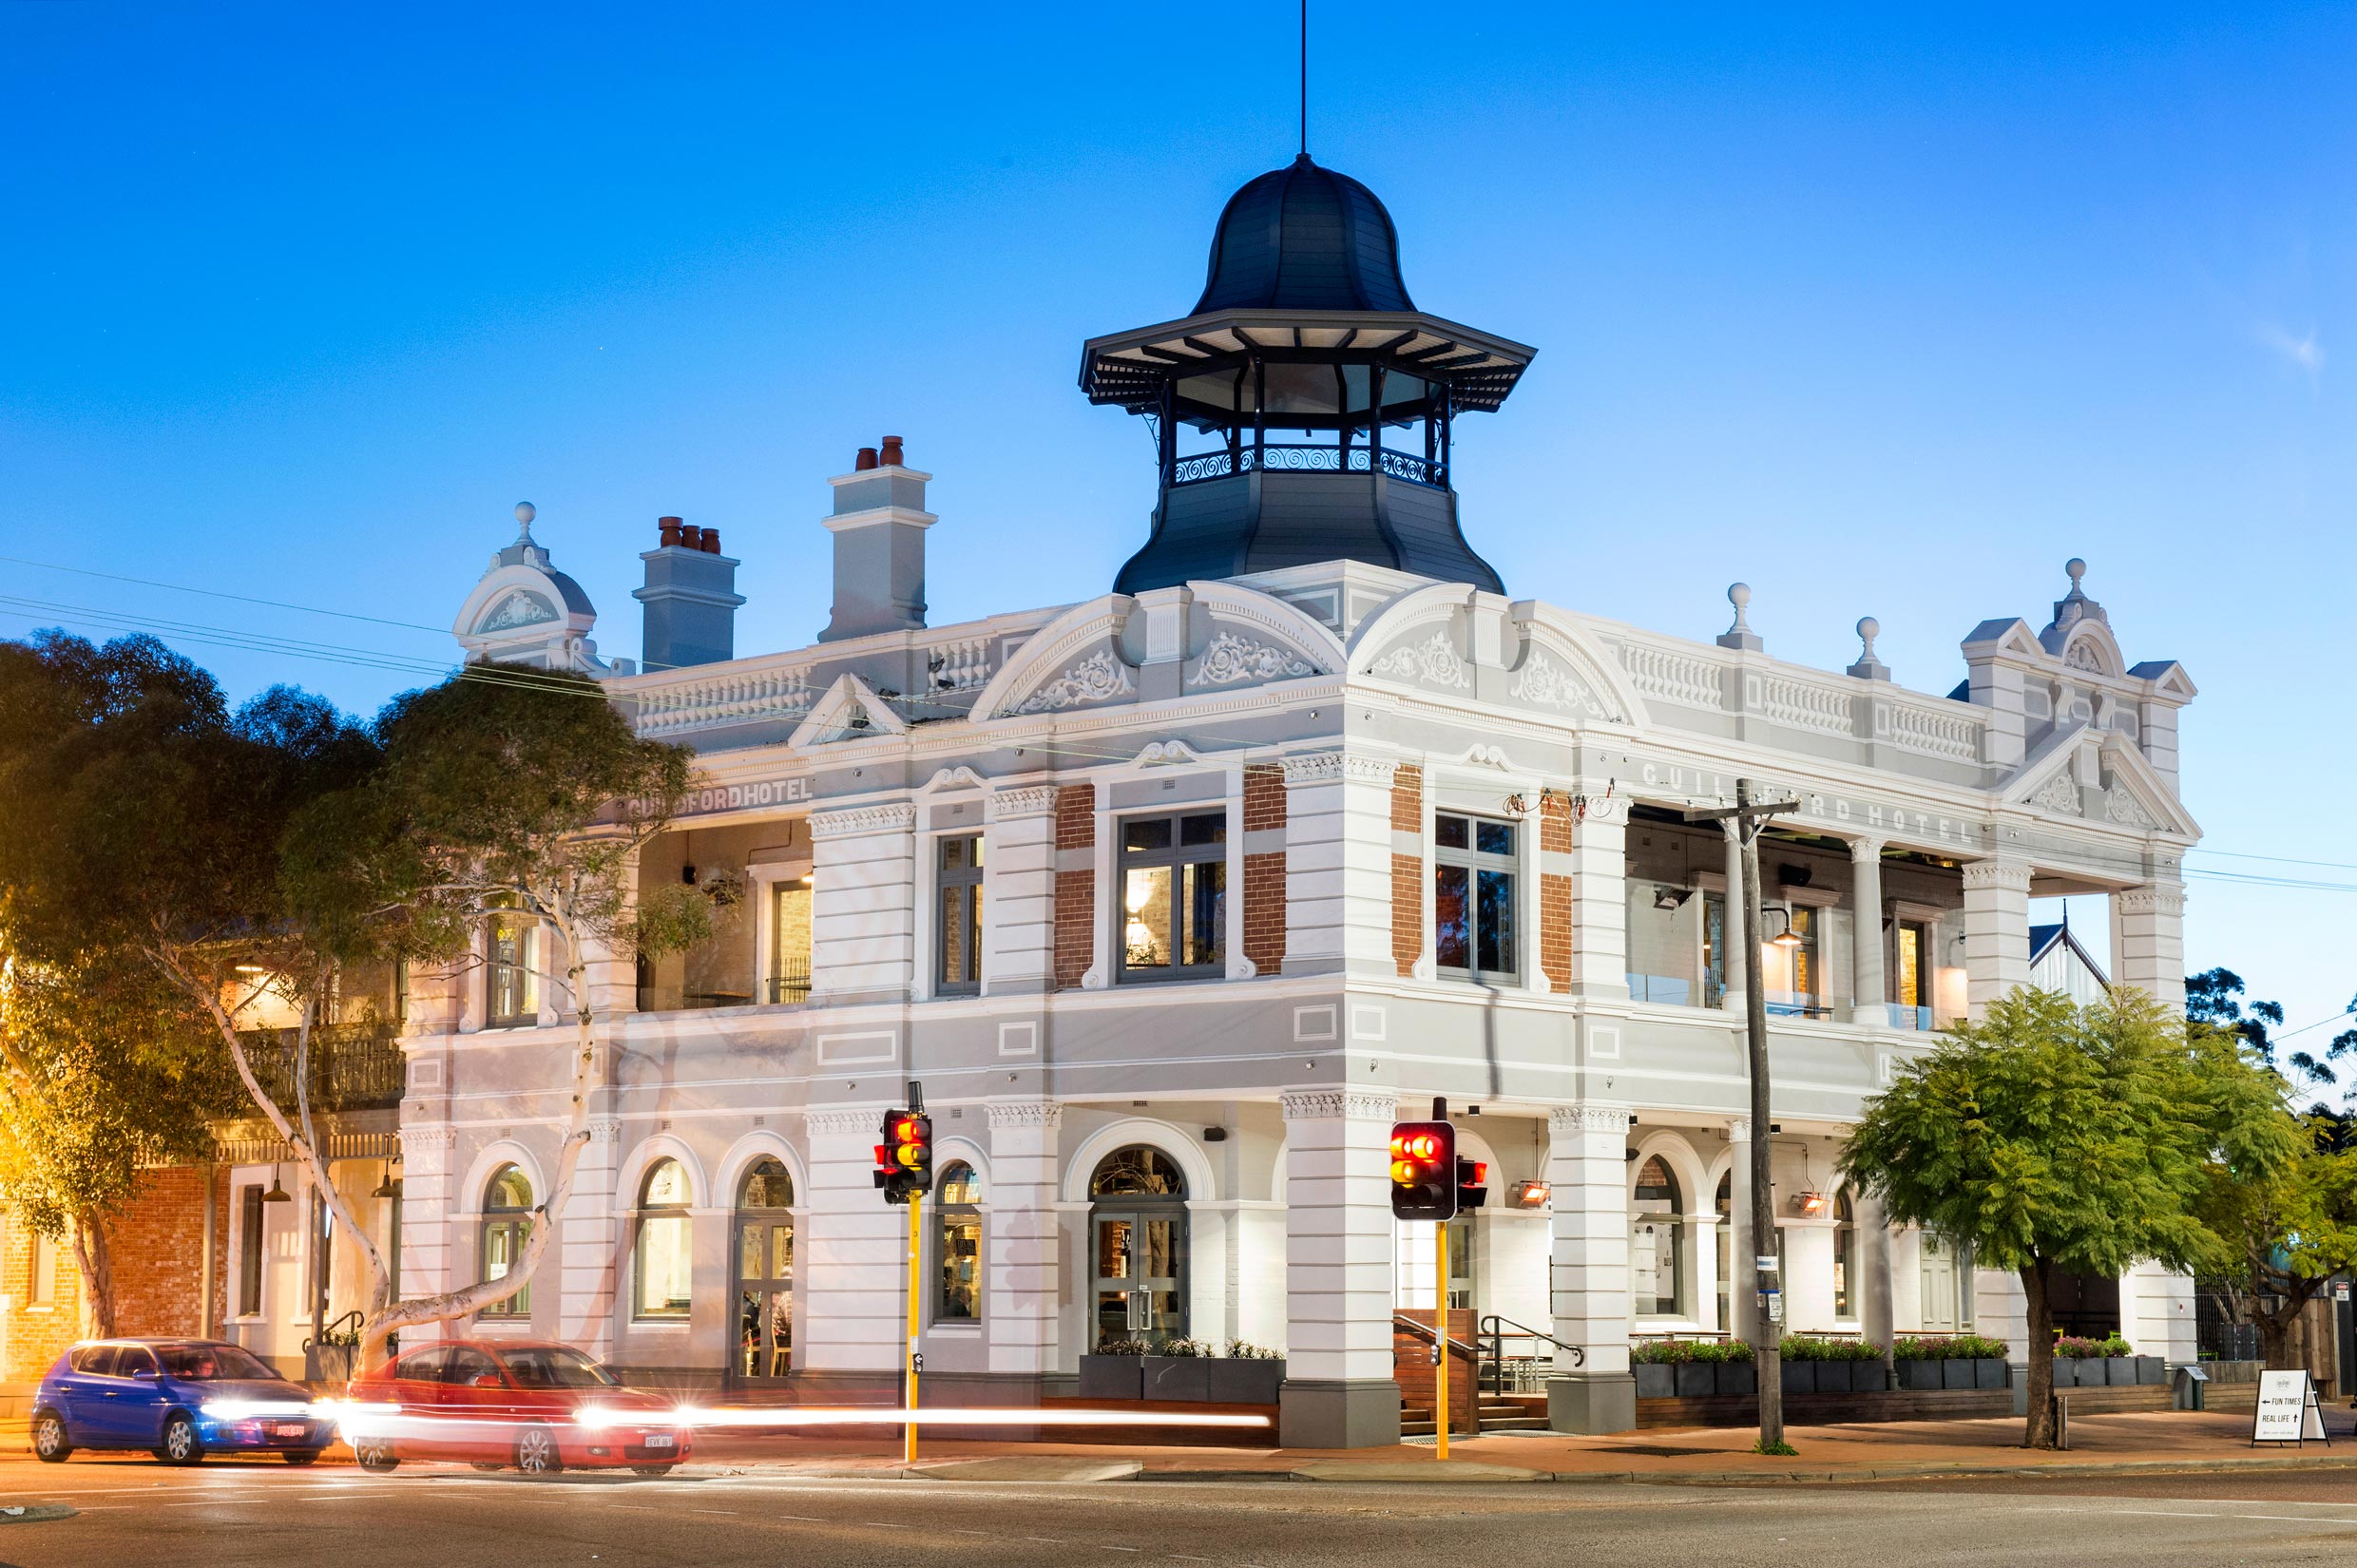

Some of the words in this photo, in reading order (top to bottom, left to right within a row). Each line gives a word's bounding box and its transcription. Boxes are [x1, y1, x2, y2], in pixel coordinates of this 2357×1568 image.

[743, 777, 814, 806] HOTEL
[1642, 763, 1850, 820] GUILFRD
[1868, 805, 1972, 844] HOTEL
[2271, 1397, 2283, 1405] FUN
[2284, 1397, 2302, 1405] TIMES
[2262, 1414, 2276, 1423] REAL
[2277, 1414, 2290, 1423] LIFE
